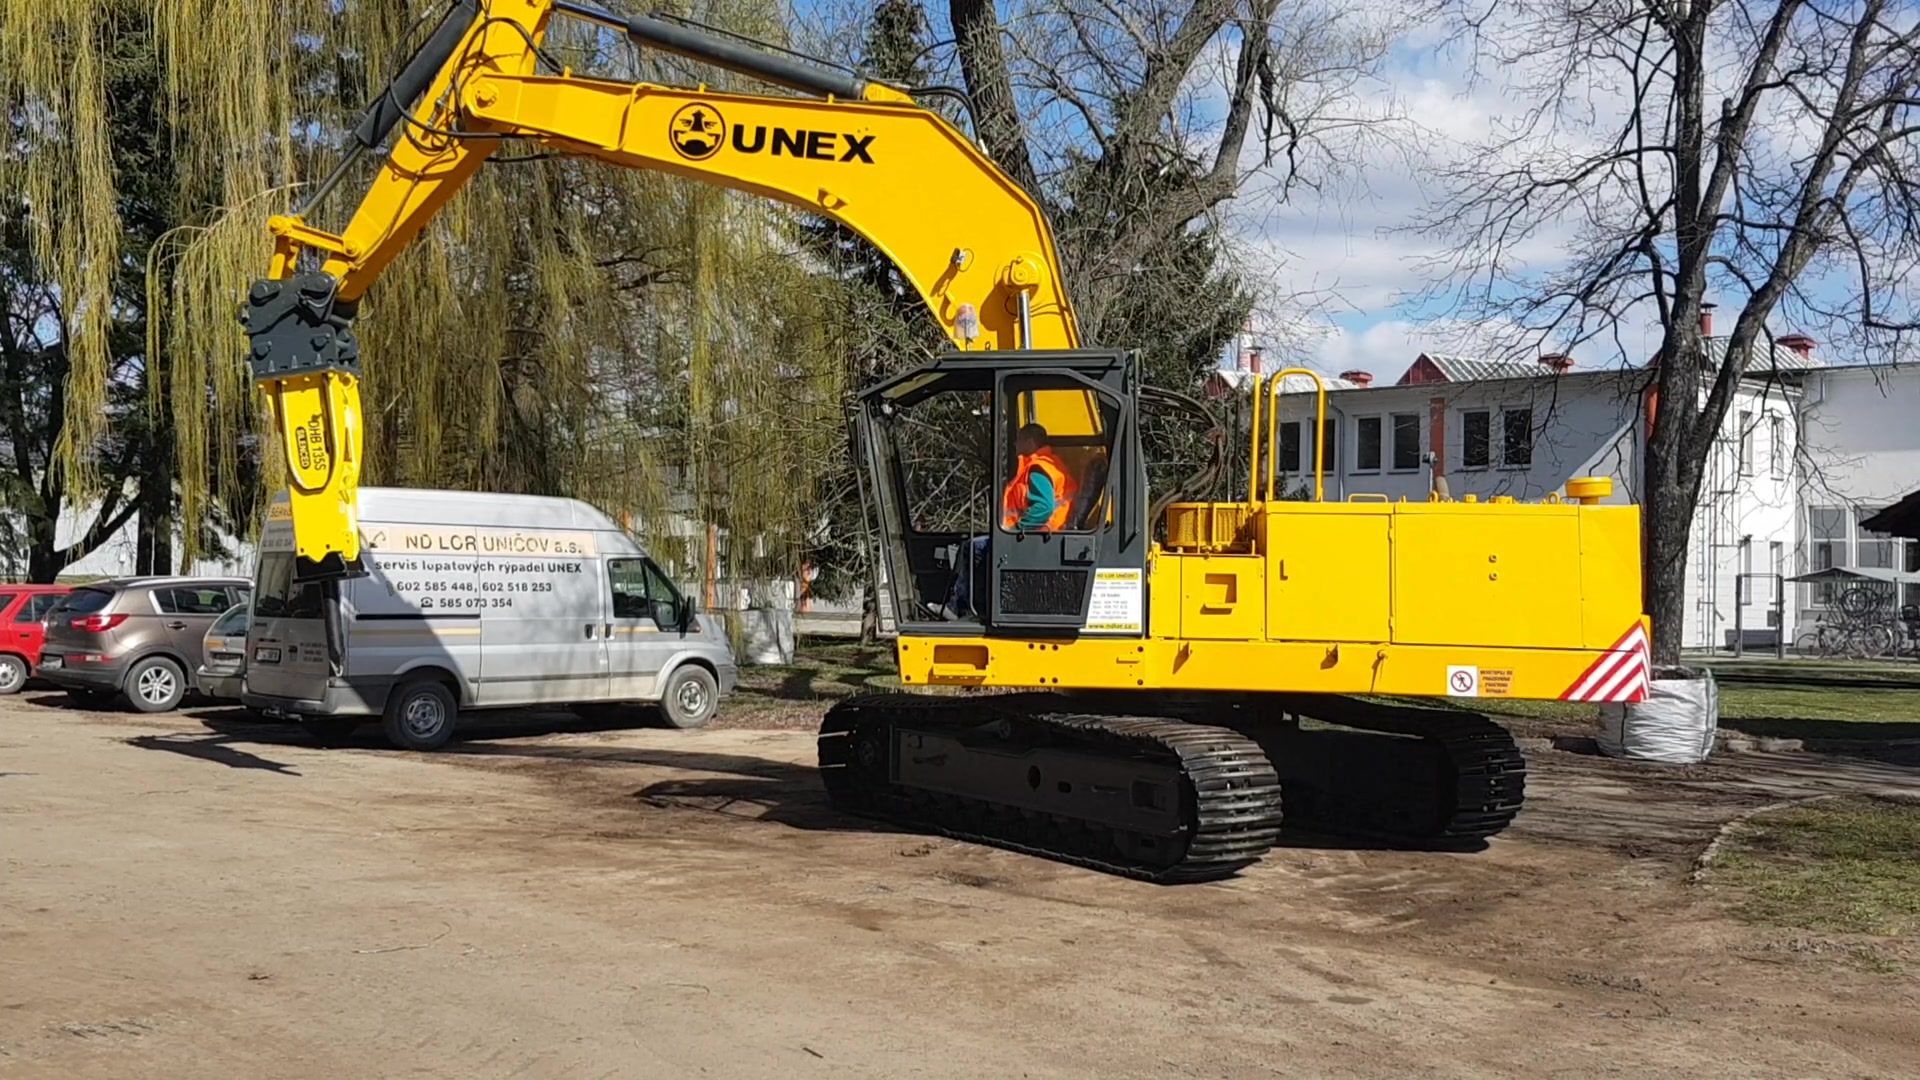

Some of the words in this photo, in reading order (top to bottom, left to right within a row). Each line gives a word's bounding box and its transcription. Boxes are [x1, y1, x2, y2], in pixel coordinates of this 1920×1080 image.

[732, 124, 876, 164] UNEX
[312, 447, 326, 471] 135S
[406, 534, 432, 549] ND
[483, 533, 548, 552] UNIČOV
[554, 541, 582, 554] a.s.
[375, 559, 417, 570] servis
[422, 560, 494, 573] lopatových
[499, 561, 544, 574] rýpadel
[548, 563, 582, 573] UNEX
[397, 581, 420, 591] 602
[424, 582, 447, 591] 585
[451, 582, 478, 593] 448,
[482, 582, 504, 592] 602
[507, 582, 528, 592] 518
[532, 582, 552, 592] 253
[439, 598, 462, 608] 585
[466, 598, 488, 608] 073
[491, 598, 513, 608] 354
